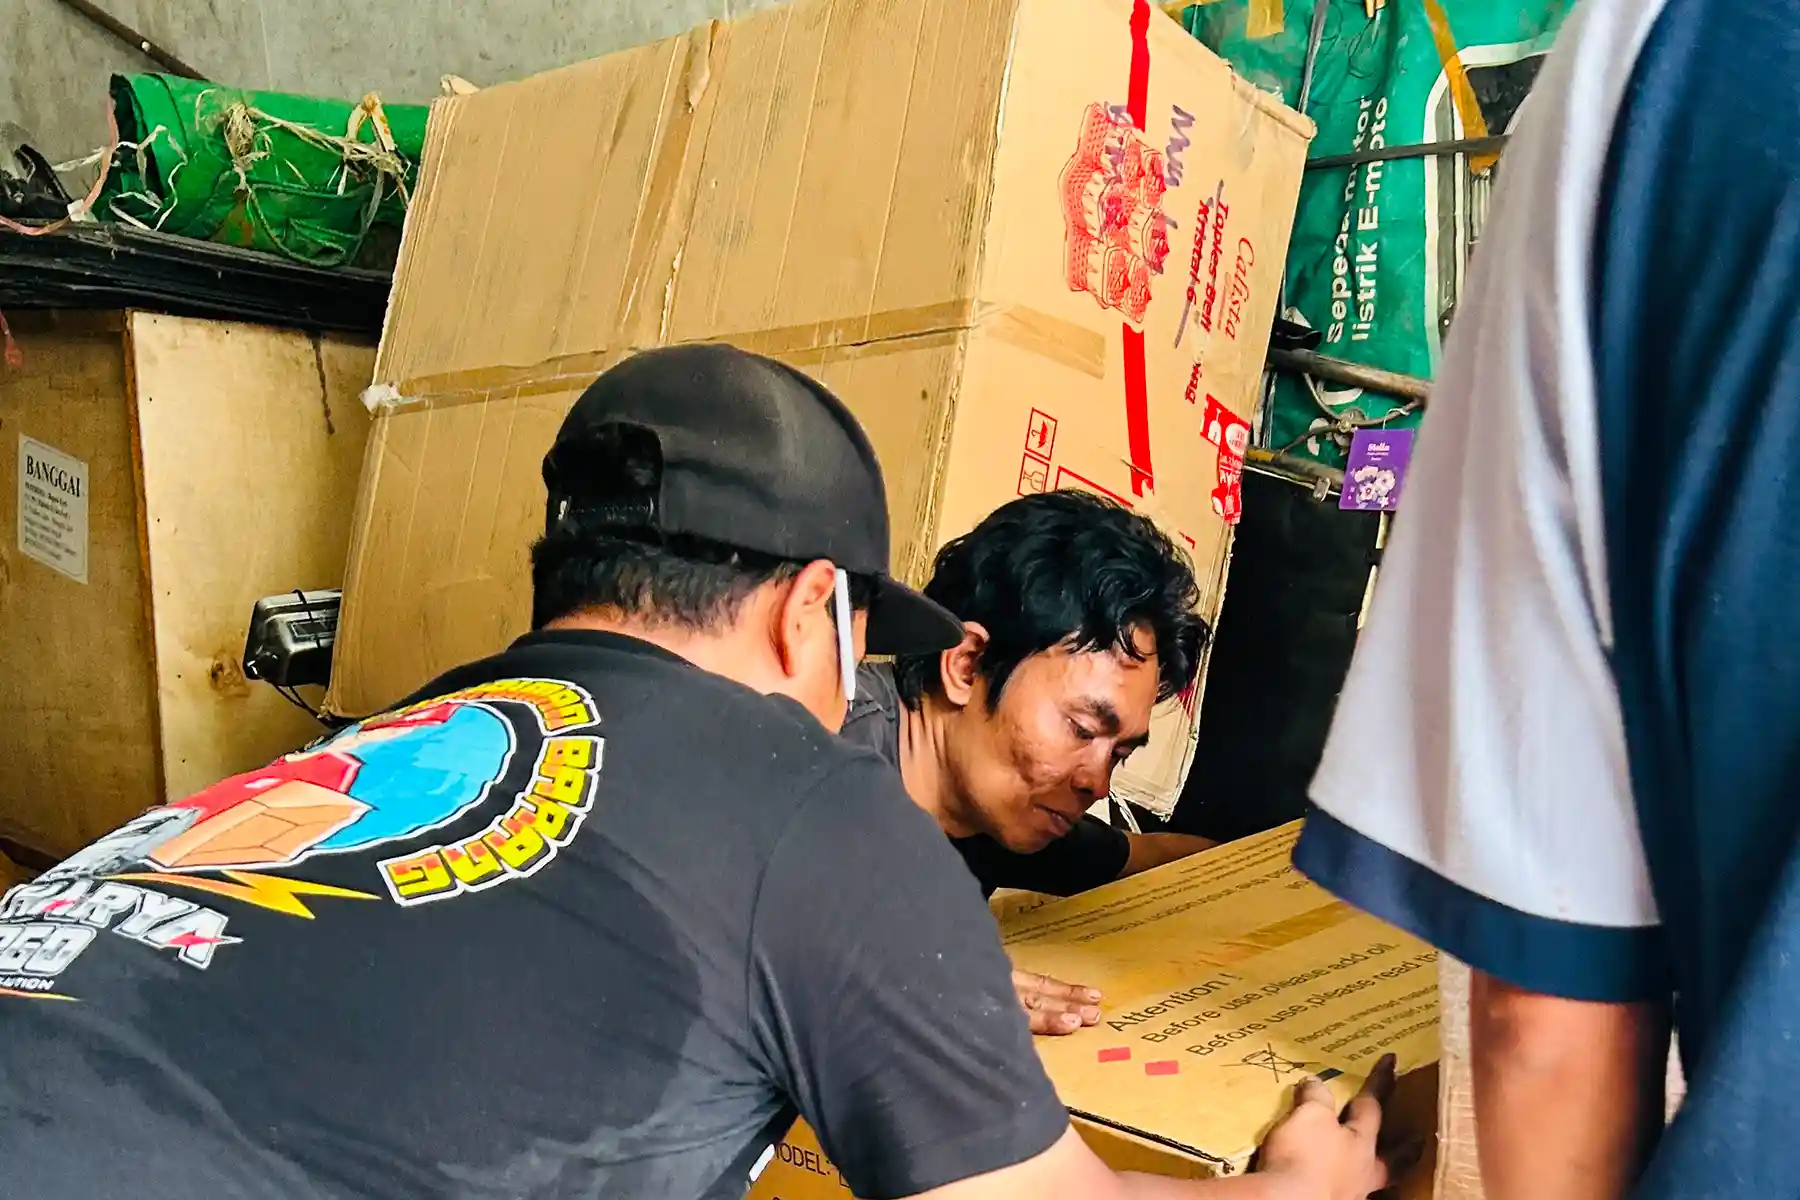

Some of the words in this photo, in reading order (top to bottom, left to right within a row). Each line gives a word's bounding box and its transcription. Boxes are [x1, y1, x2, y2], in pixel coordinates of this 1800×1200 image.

[1344, 95, 1373, 202] mtor
[1225, 237, 1255, 340] Calista
[1352, 242, 1378, 341] listrik
[26, 455, 81, 497] BANGGAI
[1106, 977, 1220, 1032] Attention
[1141, 1008, 1221, 1043] Before
[1327, 952, 1371, 970] add
[1186, 1022, 1267, 1056] Before
[1373, 959, 1422, 981] read
